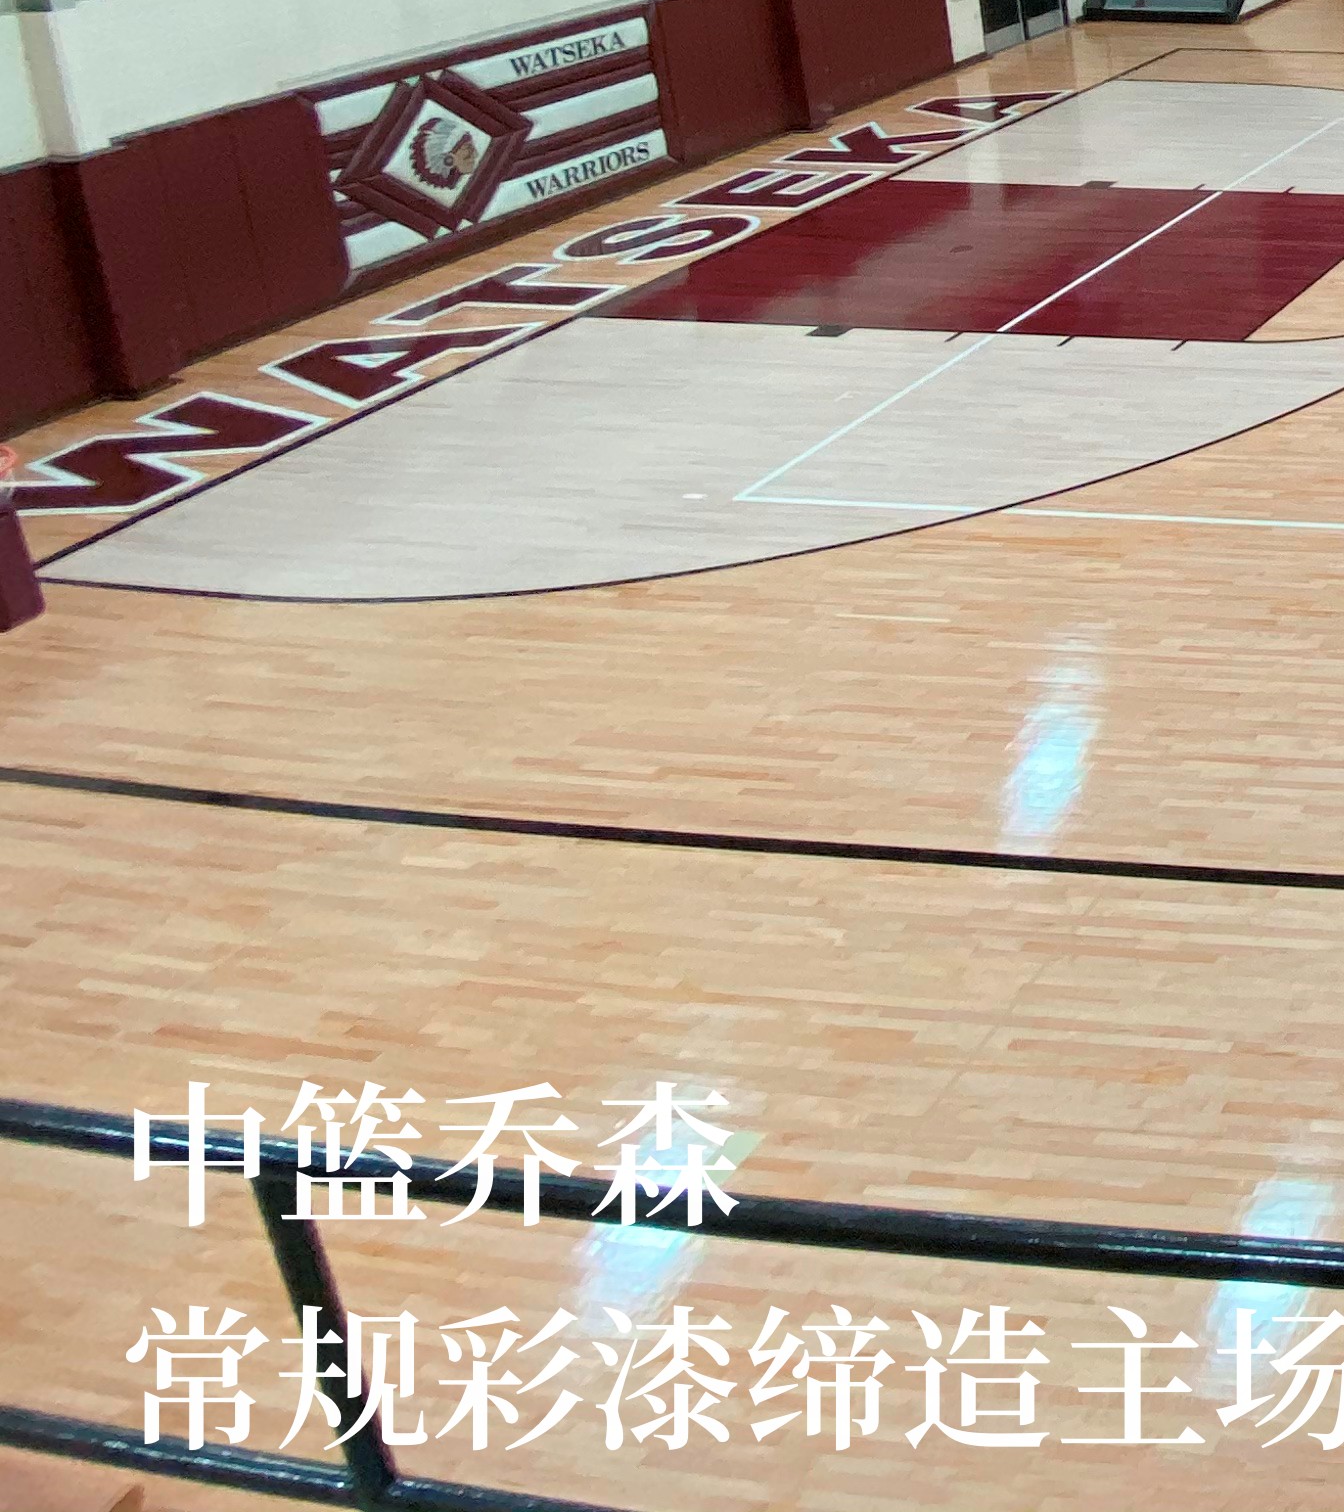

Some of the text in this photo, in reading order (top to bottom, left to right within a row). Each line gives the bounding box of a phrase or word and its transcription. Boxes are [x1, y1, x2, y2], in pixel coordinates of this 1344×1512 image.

[508, 31, 627, 80] WATSEKA
[524, 140, 652, 202] WARRIORS
[0, 89, 1071, 517] WATSEKA
